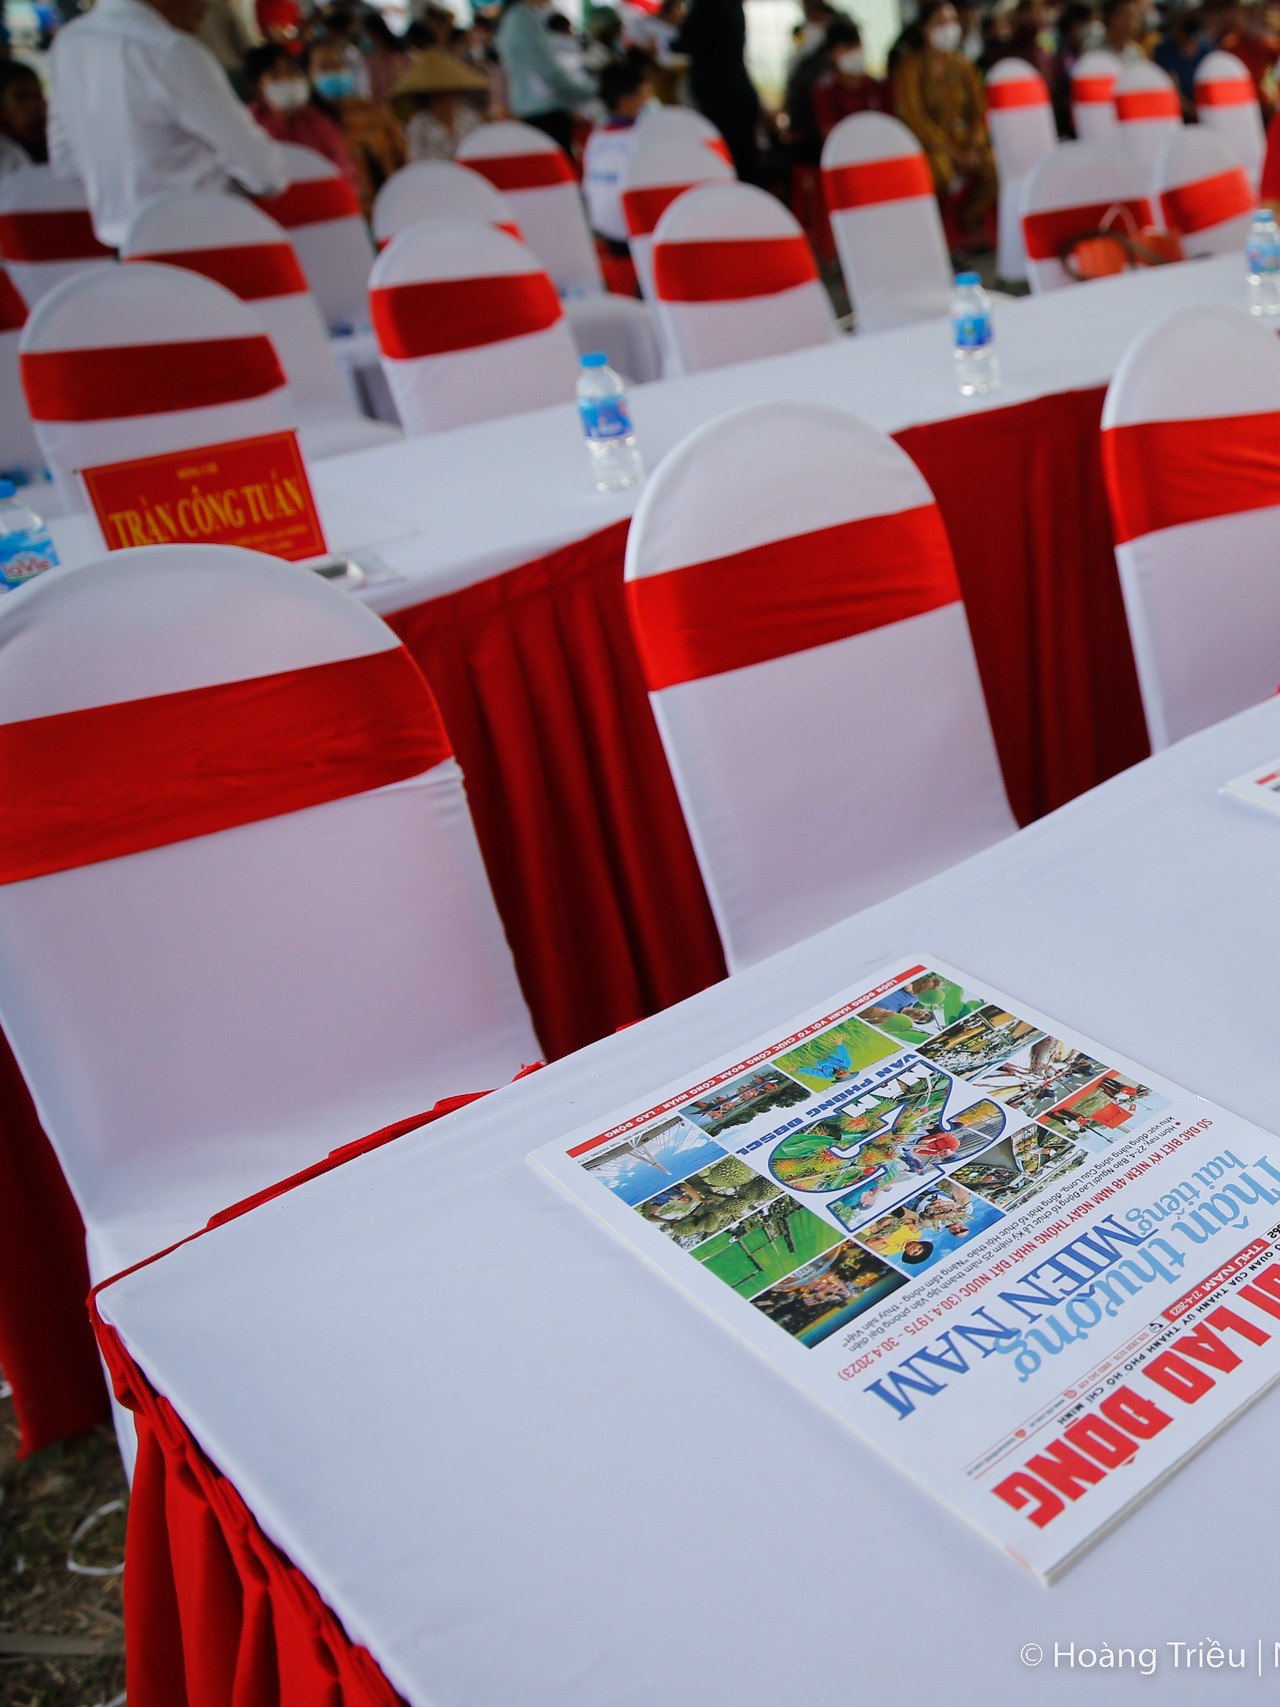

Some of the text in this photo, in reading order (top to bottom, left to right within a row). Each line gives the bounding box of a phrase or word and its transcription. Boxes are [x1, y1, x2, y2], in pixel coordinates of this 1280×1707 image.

[177, 485, 244, 538] CÔNG
[839, 1063, 937, 1120] NĂM
[634, 1110, 656, 1122] LAO
[1158, 1115, 1175, 1126] khu
[1195, 1118, 1214, 1130] SỐ
[734, 1116, 804, 1157] ĐBSCL
[1178, 1126, 1202, 1141] ĐẶC
[745, 1059, 1027, 1234] 25
[1126, 1145, 1147, 1158] 27-4,
[1158, 1138, 1184, 1156] BIỆT
[1122, 1160, 1153, 1180] NIỆM
[1060, 1179, 1083, 1195] Long,
[1078, 1182, 1094, 1193] Lao
[1110, 1177, 1128, 1189] 48
[1090, 1186, 1116, 1204] NĂM
[1065, 1200, 1096, 1222] NGÀY
[1034, 1219, 1070, 1244] THỐNG
[980, 1250, 994, 1261] 25
[1007, 1240, 1040, 1264] NHẤT
[1247, 1251, 1274, 1271] QUAN
[987, 1258, 1014, 1278] ĐẤT
[1167, 1242, 1265, 1317] THỨ NĂM 27-4-2023
[863, 1148, 1253, 1420] hai tiếng MIỀN NAM
[958, 1272, 994, 1298] NƯỚC
[981, 1227, 1185, 1382] thương
[1195, 1288, 1230, 1314] THÀNH
[904, 1294, 962, 1335] (30.4.1975
[1146, 1326, 1181, 1353] THÀNH
[838, 1337, 899, 1381] 30.4.2023)
[1142, 1306, 1271, 1404] LAO
[1084, 1386, 1105, 1403] CHÍ
[1056, 1402, 1085, 1425] MINH
[992, 1385, 1174, 1528] ĐỘNG
